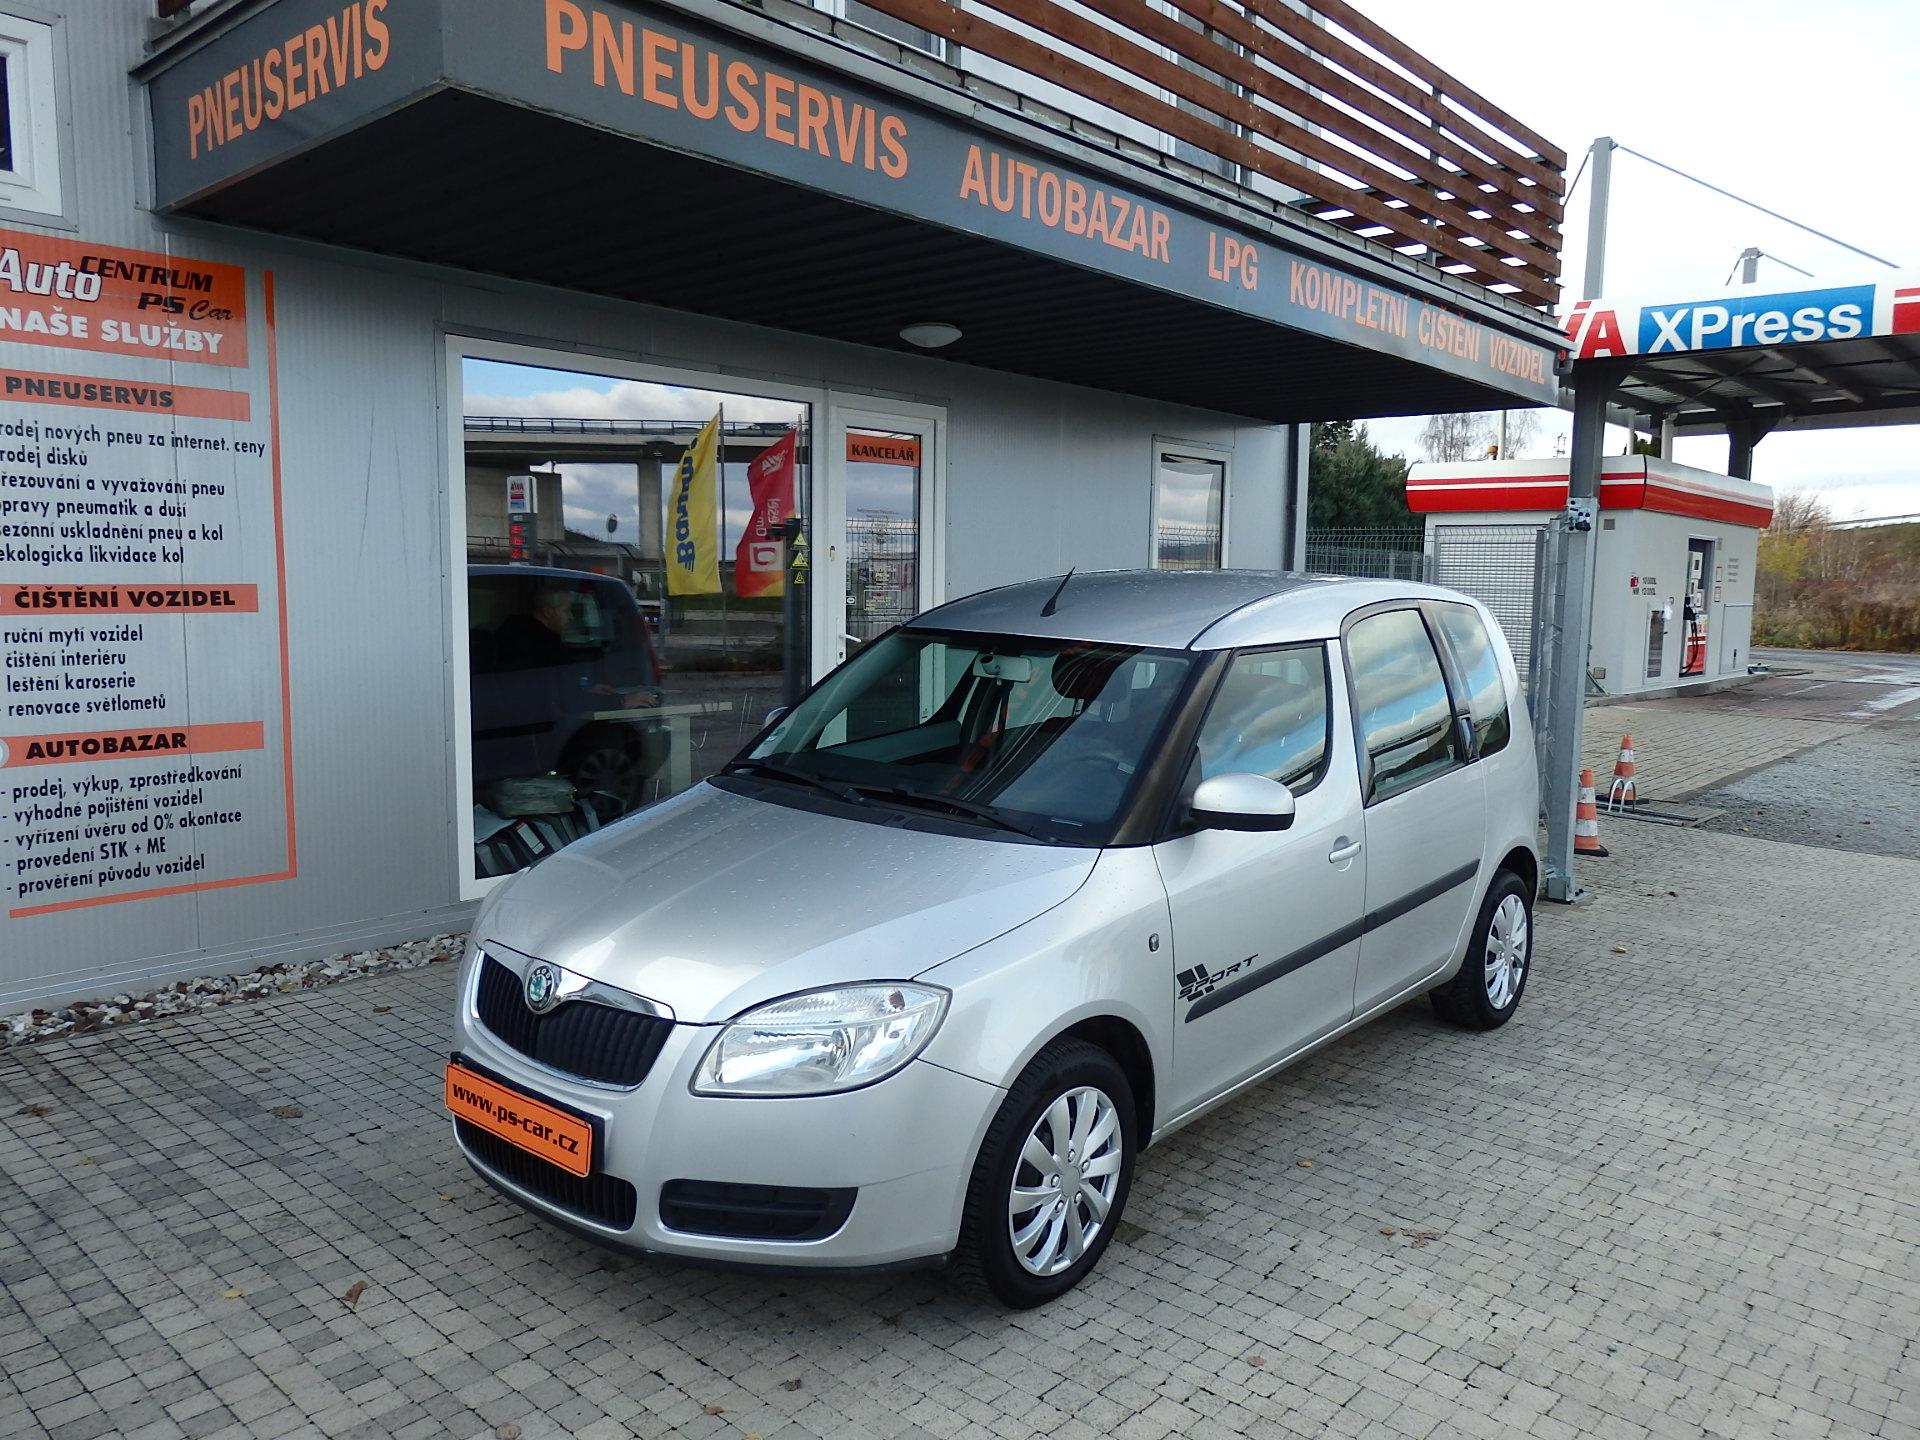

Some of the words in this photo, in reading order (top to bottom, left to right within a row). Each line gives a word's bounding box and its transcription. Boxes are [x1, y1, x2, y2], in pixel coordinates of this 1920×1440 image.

[187, 0, 390, 160] PNEUSERVIS
[545, 0, 908, 179] PNEUSERVIS
[960, 144, 1170, 263] AUTOBAZAR
[1207, 232, 1258, 291] LPG
[1489, 333, 1545, 384] VOZIDEL
[0, 247, 103, 302] Auto
[81, 255, 213, 292] CENTRUM
[138, 292, 186, 314] PS
[189, 299, 233, 320] Car
[0, 305, 89, 338] NAŠE
[101, 319, 224, 353] SLUŽBY
[1648, 303, 1863, 353] XPress
[5, 376, 174, 407] PNEUSERVIS
[45, 424, 101, 445] nových
[107, 431, 142, 447] pneu
[149, 434, 165, 447] za
[171, 431, 229, 451] internet.
[234, 441, 266, 457] ceny
[852, 444, 914, 461] KANCELÁŘ
[47, 447, 87, 466] disků
[87, 479, 95, 490] a
[102, 477, 186, 495] vyvažování
[192, 483, 225, 498] pneu
[0, 500, 50, 517] pravy
[57, 498, 138, 518] pneumatik
[145, 506, 153, 516] a
[159, 500, 187, 517] duší
[0, 521, 55, 538] ezónní
[60, 521, 143, 539] uskladnění
[149, 528, 183, 543] pneu
[188, 530, 196, 541] a
[202, 523, 223, 541] kol
[0, 543, 83, 567] ekologická
[90, 545, 157, 563] likvidace
[163, 546, 184, 563] kol
[14, 586, 119, 608] ČIŠTĚNÍ
[127, 590, 236, 608] VOZIDEL
[4, 627, 43, 643] ruční
[50, 627, 84, 647] mytí
[90, 624, 143, 642] vozidel
[6, 650, 56, 668] čištění
[61, 649, 126, 666] interiéru
[7, 674, 59, 692] leštění
[65, 671, 136, 690] karoserie
[8, 701, 80, 716] renovace
[86, 693, 166, 713] světlometů
[25, 732, 188, 760] AUTOBAZAR
[13, 778, 67, 803] prodej,
[72, 774, 124, 798] výkup,
[129, 763, 242, 791] zprostředkování
[14, 800, 82, 826] výhodné
[88, 793, 149, 820] pojištění
[153, 788, 203, 808] vozidel
[16, 824, 79, 850] vyřízení
[84, 822, 126, 840] úvěru
[131, 816, 148, 833] od
[153, 812, 174, 832] 0%
[179, 810, 242, 829] akontace
[17, 846, 95, 875] provedení
[100, 840, 129, 860] STK
[146, 836, 167, 855] ME
[19, 872, 93, 899] prověření
[98, 860, 151, 888] původu
[155, 853, 205, 875] vozidel
[1178, 953, 1259, 1000] SPORT
[453, 1084, 579, 1156] www.ps-car.cz
